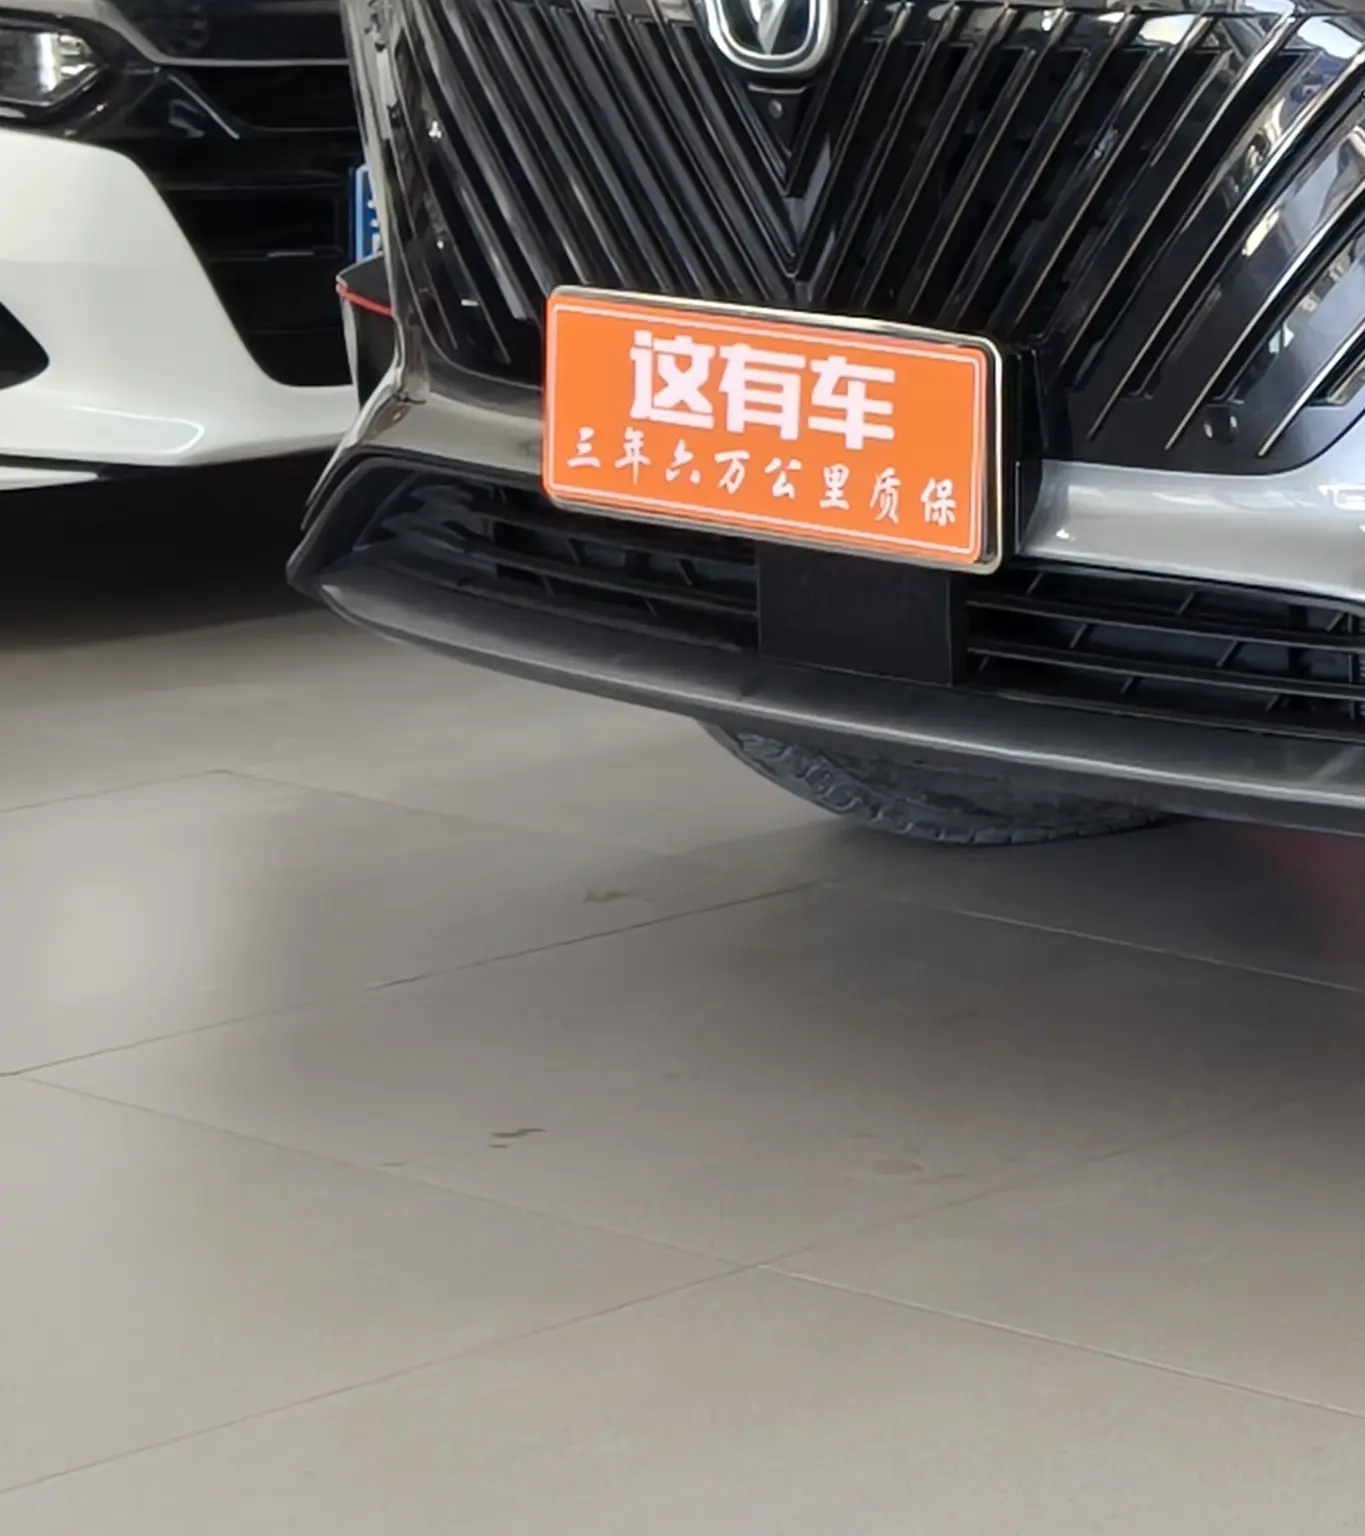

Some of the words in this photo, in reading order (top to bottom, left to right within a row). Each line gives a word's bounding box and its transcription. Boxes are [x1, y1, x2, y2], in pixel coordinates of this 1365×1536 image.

[629, 330, 895, 450] 这有车
[567, 427, 957, 527] 三年六万公里质保
